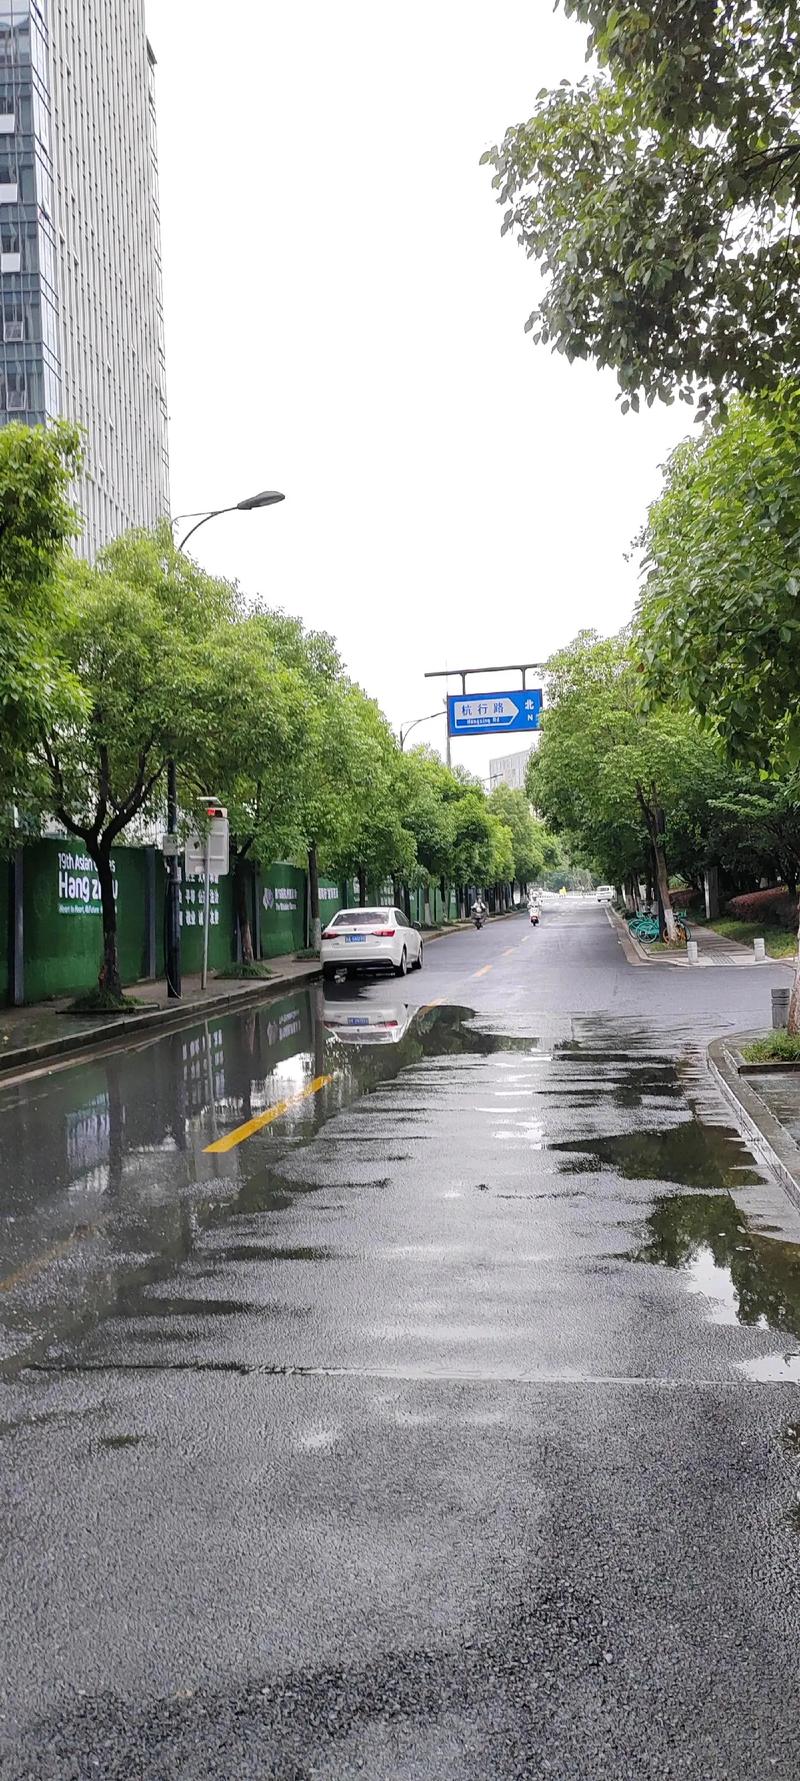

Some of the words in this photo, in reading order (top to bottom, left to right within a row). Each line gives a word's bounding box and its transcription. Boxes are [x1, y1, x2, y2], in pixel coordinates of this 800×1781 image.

[462, 702, 504, 716] 杭行路
[525, 699, 534, 710] 北
[58, 852, 74, 869] 19th
[75, 854, 93, 871] Asian
